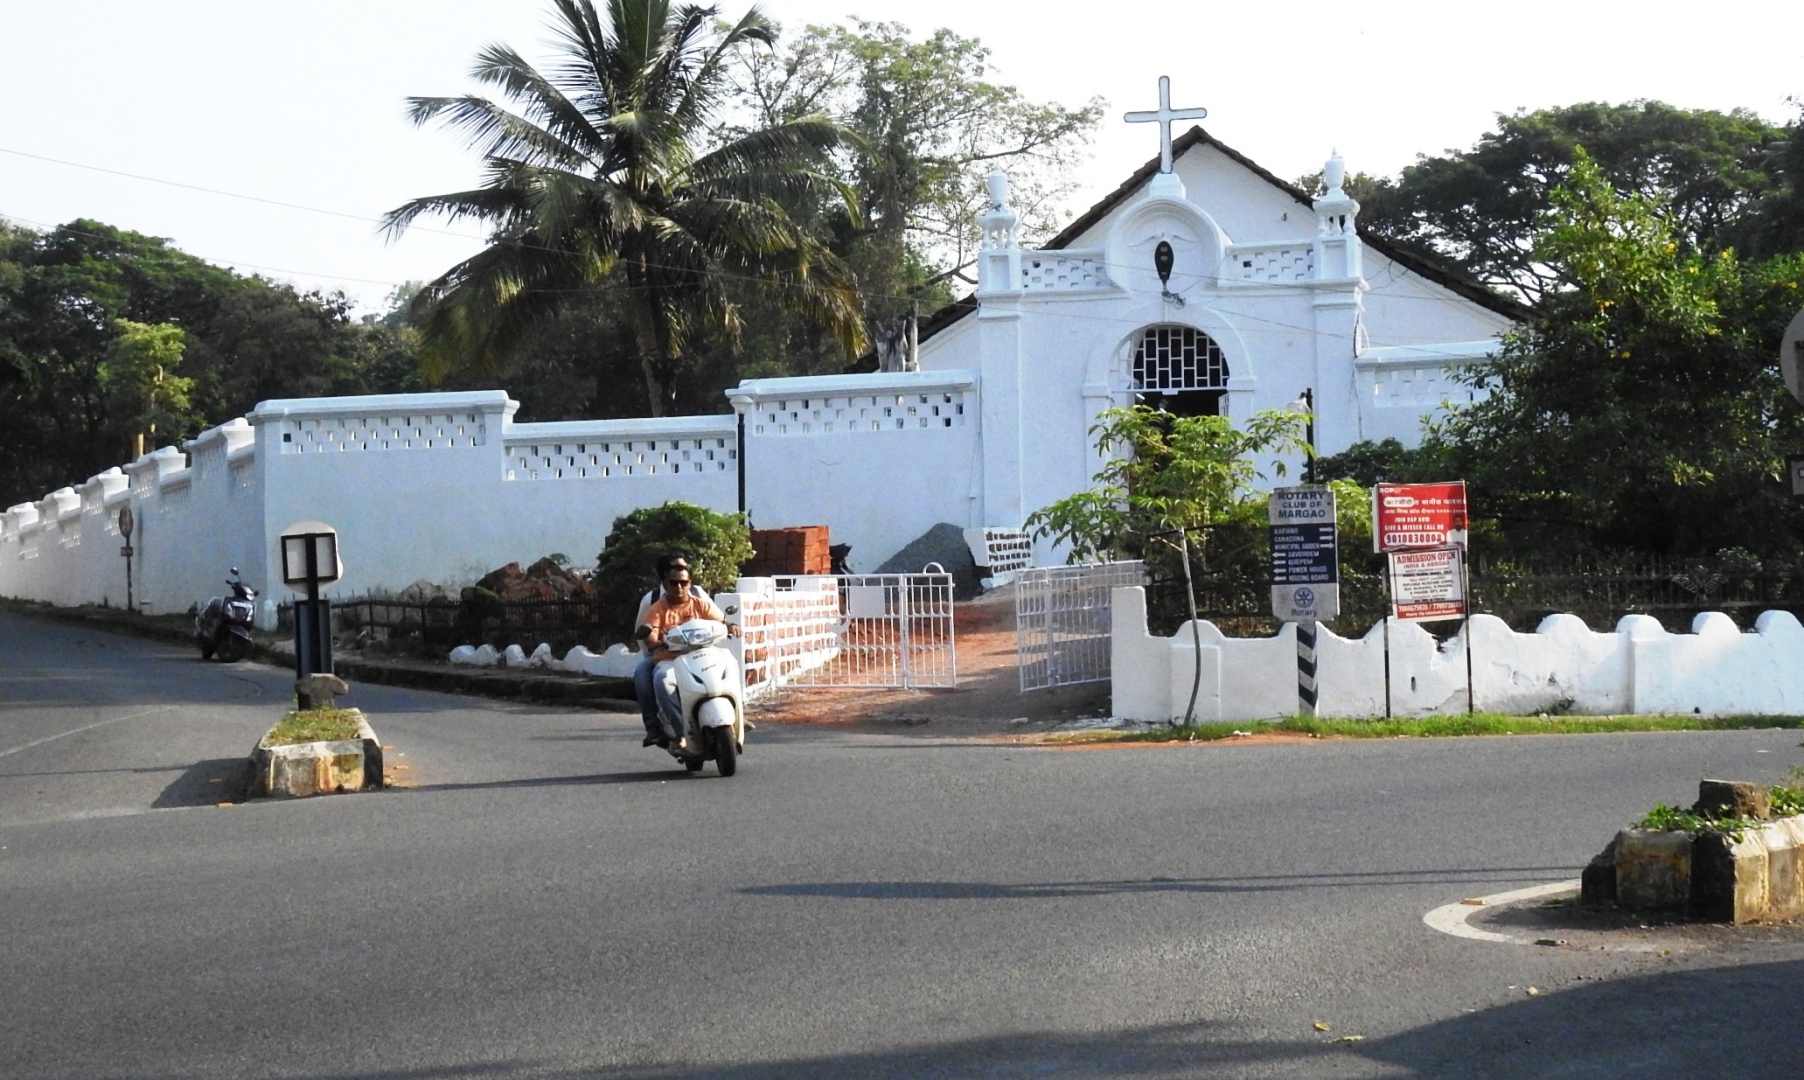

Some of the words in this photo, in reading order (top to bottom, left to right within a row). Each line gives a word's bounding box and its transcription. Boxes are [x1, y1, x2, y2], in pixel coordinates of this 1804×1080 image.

[1278, 491, 1324, 500] ROTARY
[1278, 510, 1326, 518] MARGAO
[1396, 553, 1436, 564] ADMISSION
[1438, 551, 1456, 560] OPEN
[1291, 608, 1317, 618] Rotary
